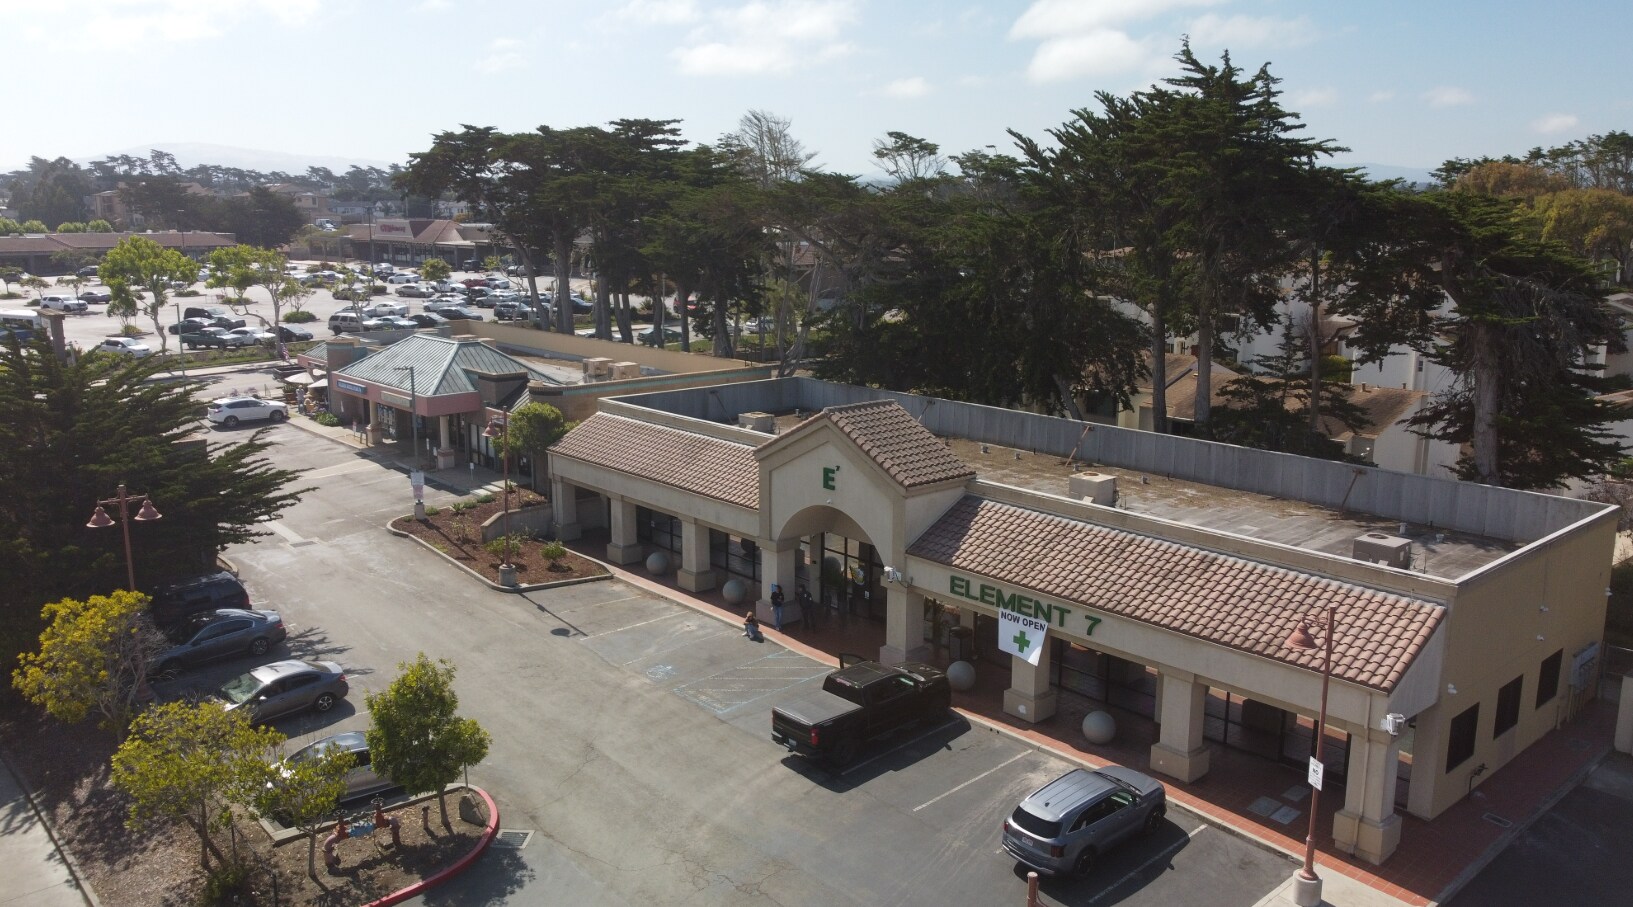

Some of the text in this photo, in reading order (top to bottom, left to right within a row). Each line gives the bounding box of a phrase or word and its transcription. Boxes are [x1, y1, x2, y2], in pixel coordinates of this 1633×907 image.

[949, 575, 1102, 636] ELEMENT 7
[1000, 611, 1046, 632] NOW OPEN
